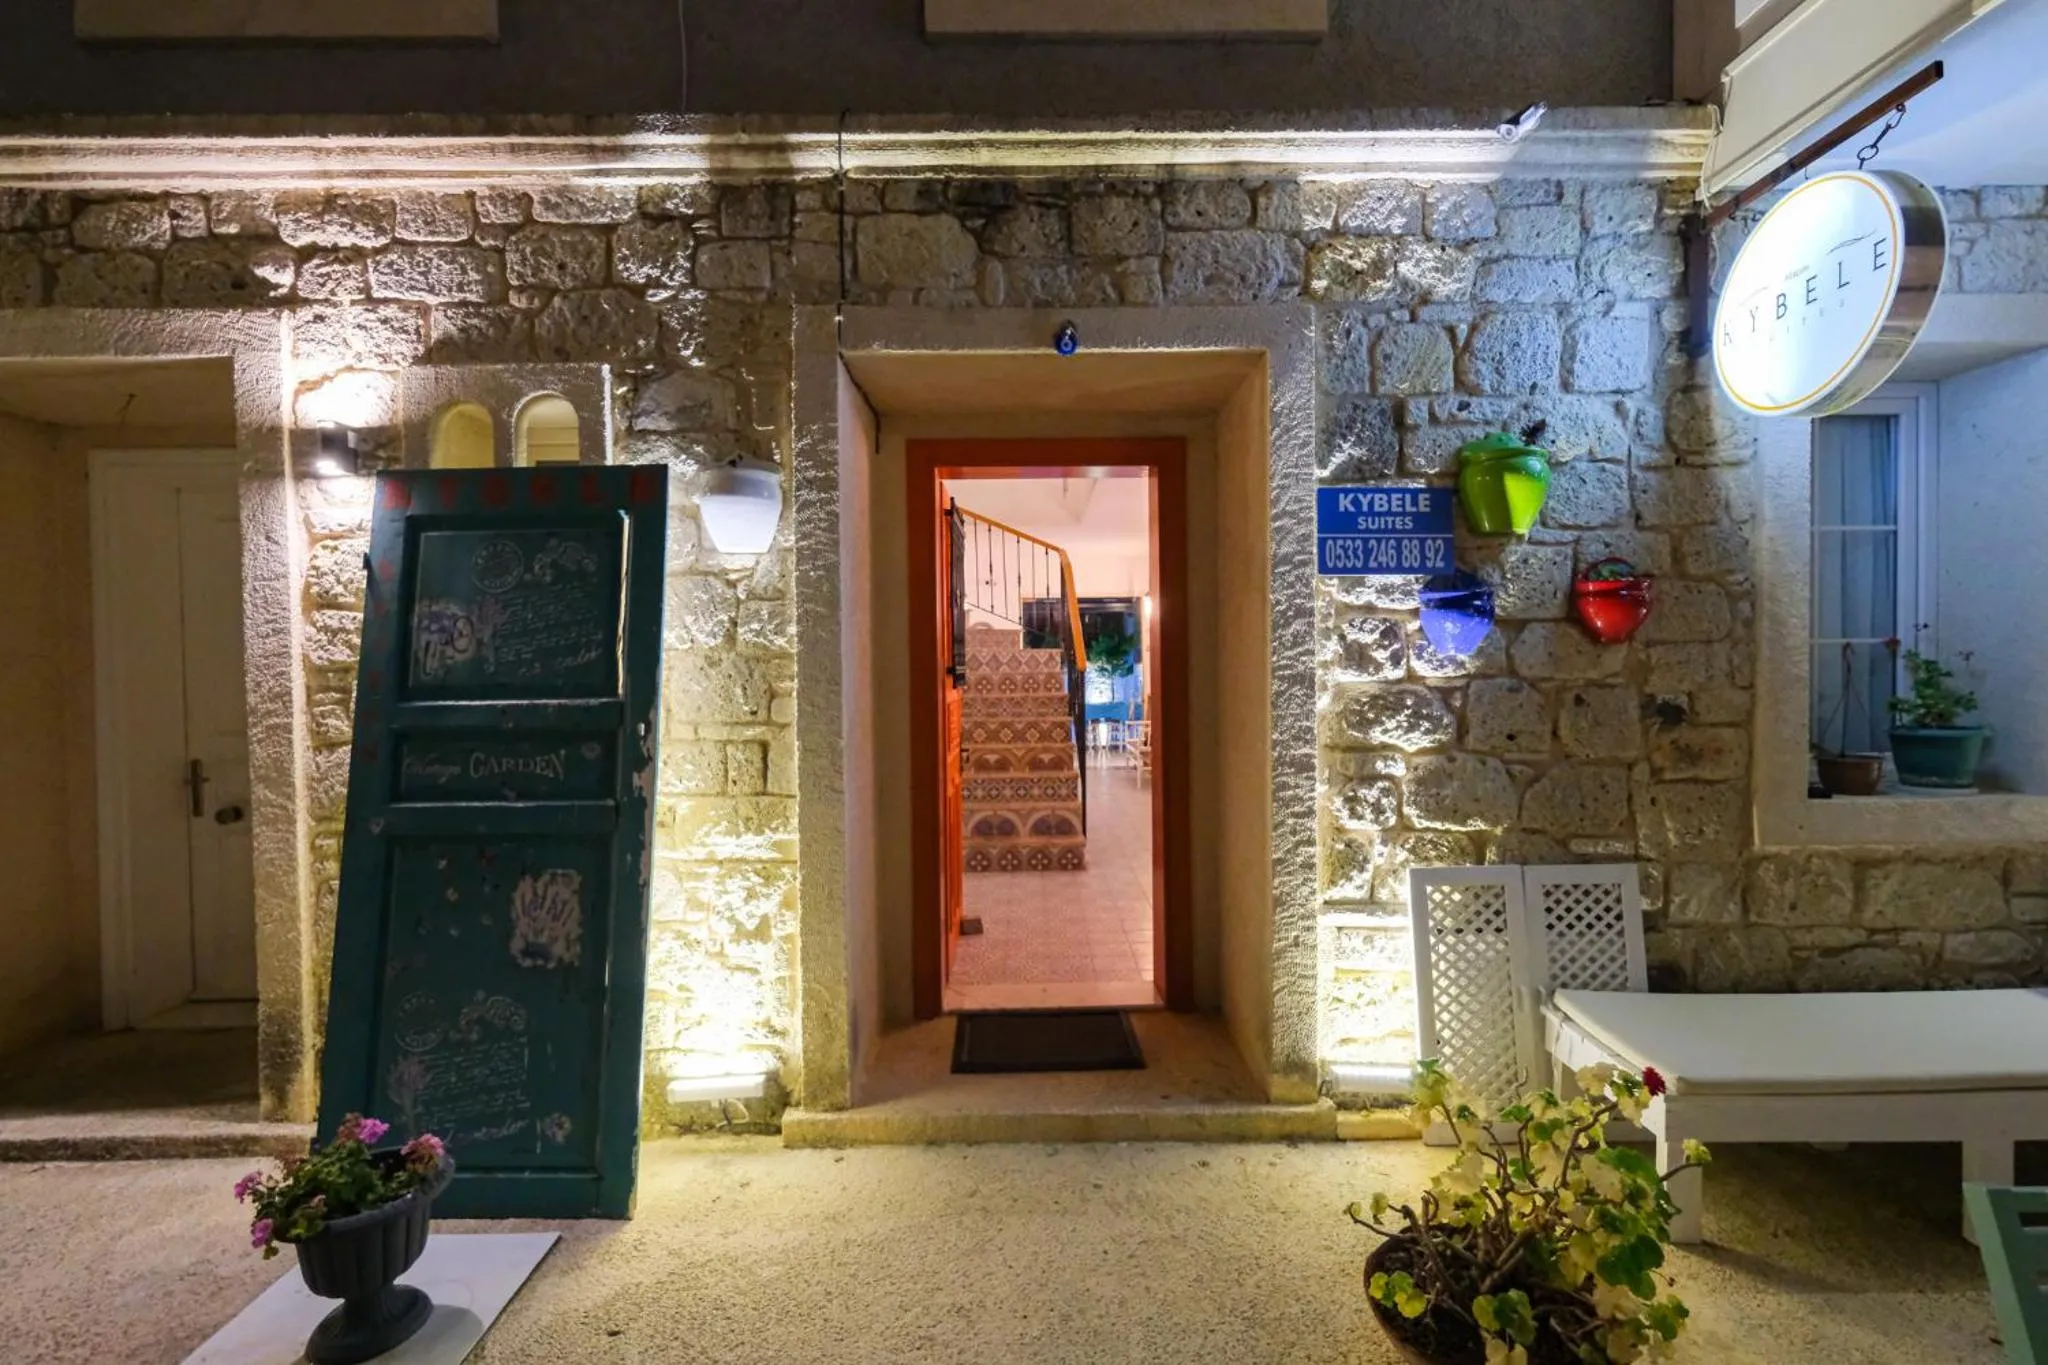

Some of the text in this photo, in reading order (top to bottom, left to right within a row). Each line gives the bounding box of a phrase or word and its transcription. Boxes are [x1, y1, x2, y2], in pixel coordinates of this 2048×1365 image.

[1723, 237, 1887, 347] KYBELE
[1338, 493, 1431, 512] KYBELE
[1357, 516, 1414, 530] SUITES
[1325, 539, 1445, 569] 0533 246 88 92
[470, 749, 566, 780] GARDEN
